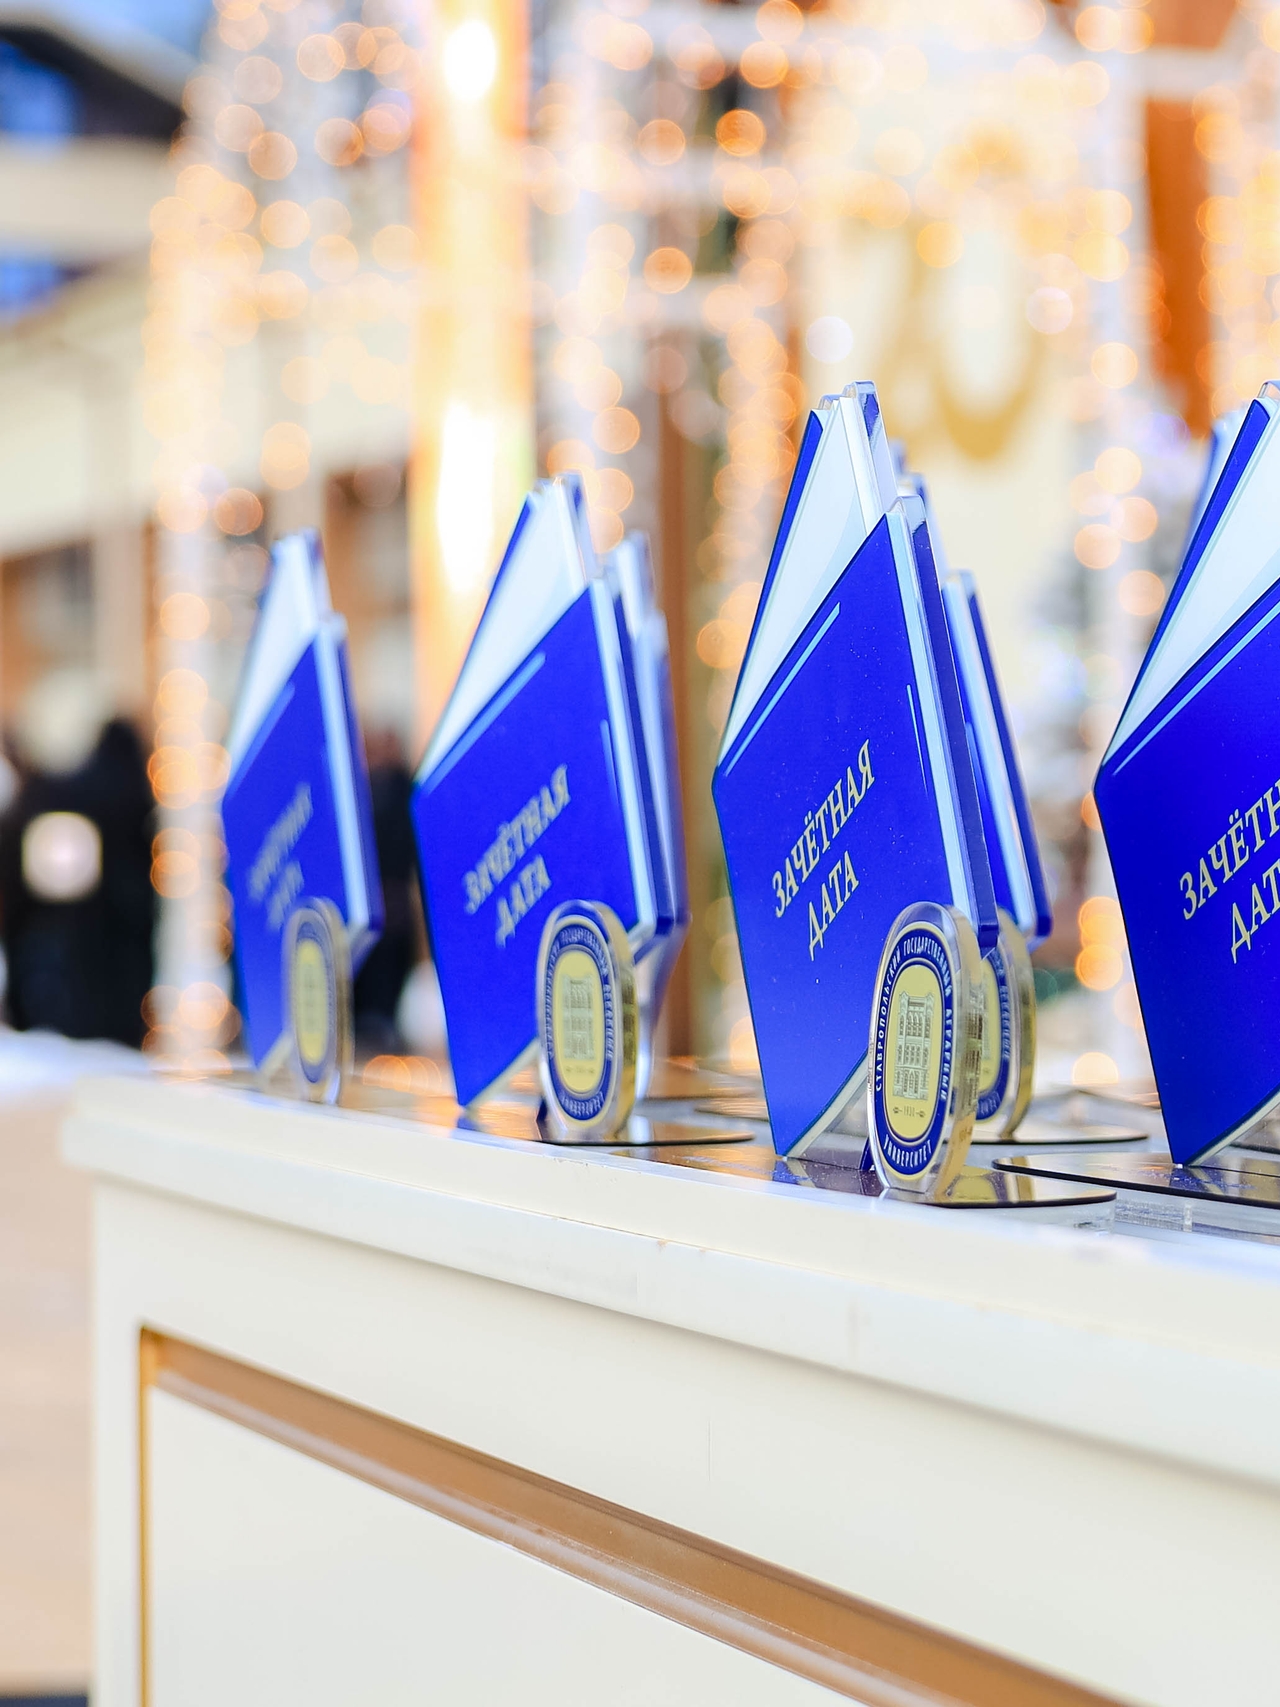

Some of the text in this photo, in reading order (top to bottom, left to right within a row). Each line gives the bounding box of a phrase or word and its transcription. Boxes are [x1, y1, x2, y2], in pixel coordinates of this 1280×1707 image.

[463, 763, 571, 915] ЗАЧЁТНАЯ
[495, 853, 551, 948] ДАТА
[772, 739, 875, 918] ЗАЧЁТНАЯ
[808, 851, 859, 961] ДАТА
[875, 945, 902, 1092] СТАВРОПОЛЬСКИЙ
